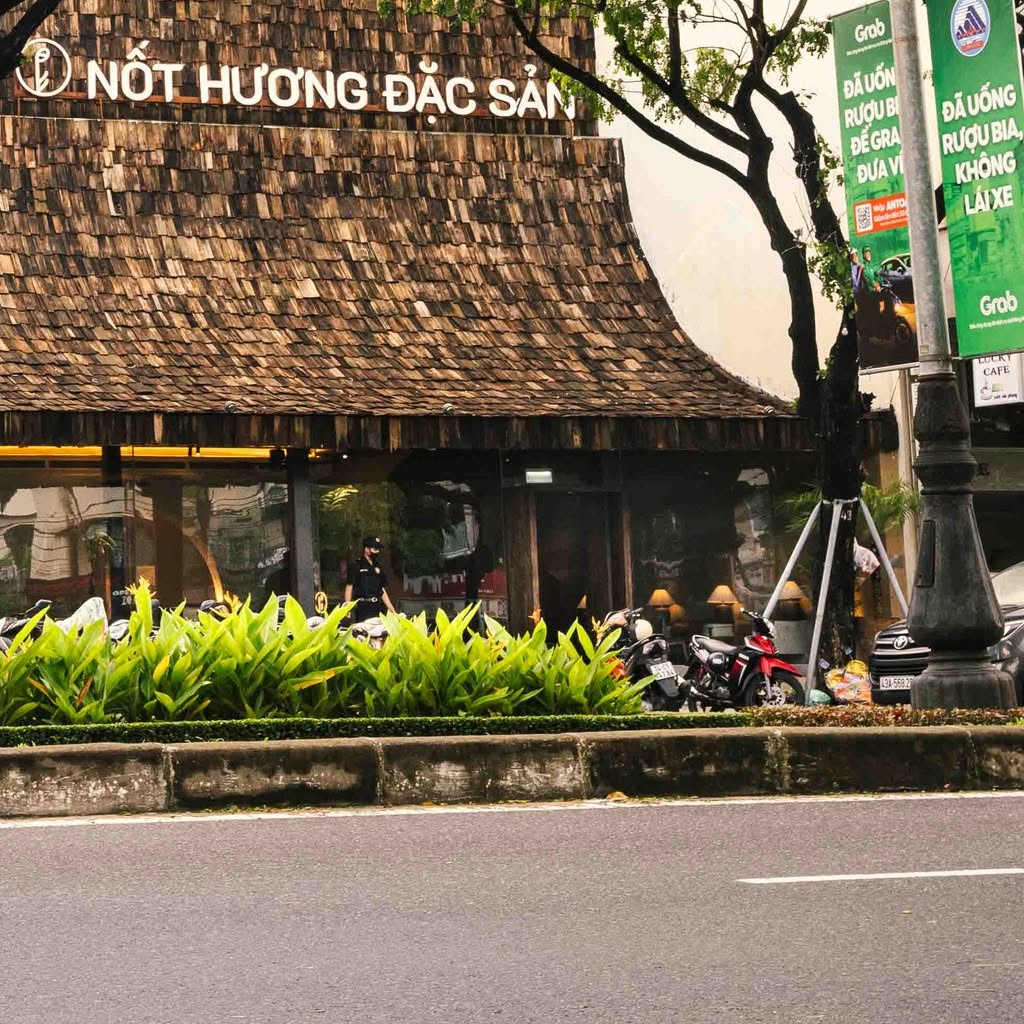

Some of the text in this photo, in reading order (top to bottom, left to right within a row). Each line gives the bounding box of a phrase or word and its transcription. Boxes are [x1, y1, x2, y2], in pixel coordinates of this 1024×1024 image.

[855, 18, 885, 43] Grab
[87, 40, 576, 125] NỐT HƯƠNG ĐẶC SẢN
[843, 62, 896, 99] ĐÃ UỐN
[844, 96, 899, 129] RƯỢU BI
[942, 81, 1017, 123] ĐÃ UỐNG
[851, 125, 901, 156] ĐỂ GRA
[942, 117, 1023, 155] RƯỢU BIA,
[857, 157, 888, 184] ĐƯA
[955, 151, 1017, 185] KHÔNG
[886, 197, 906, 211] ANTO
[964, 184, 1014, 216] LÁI XE
[979, 290, 1018, 316] Grab
[983, 365, 1010, 376] CAFE
